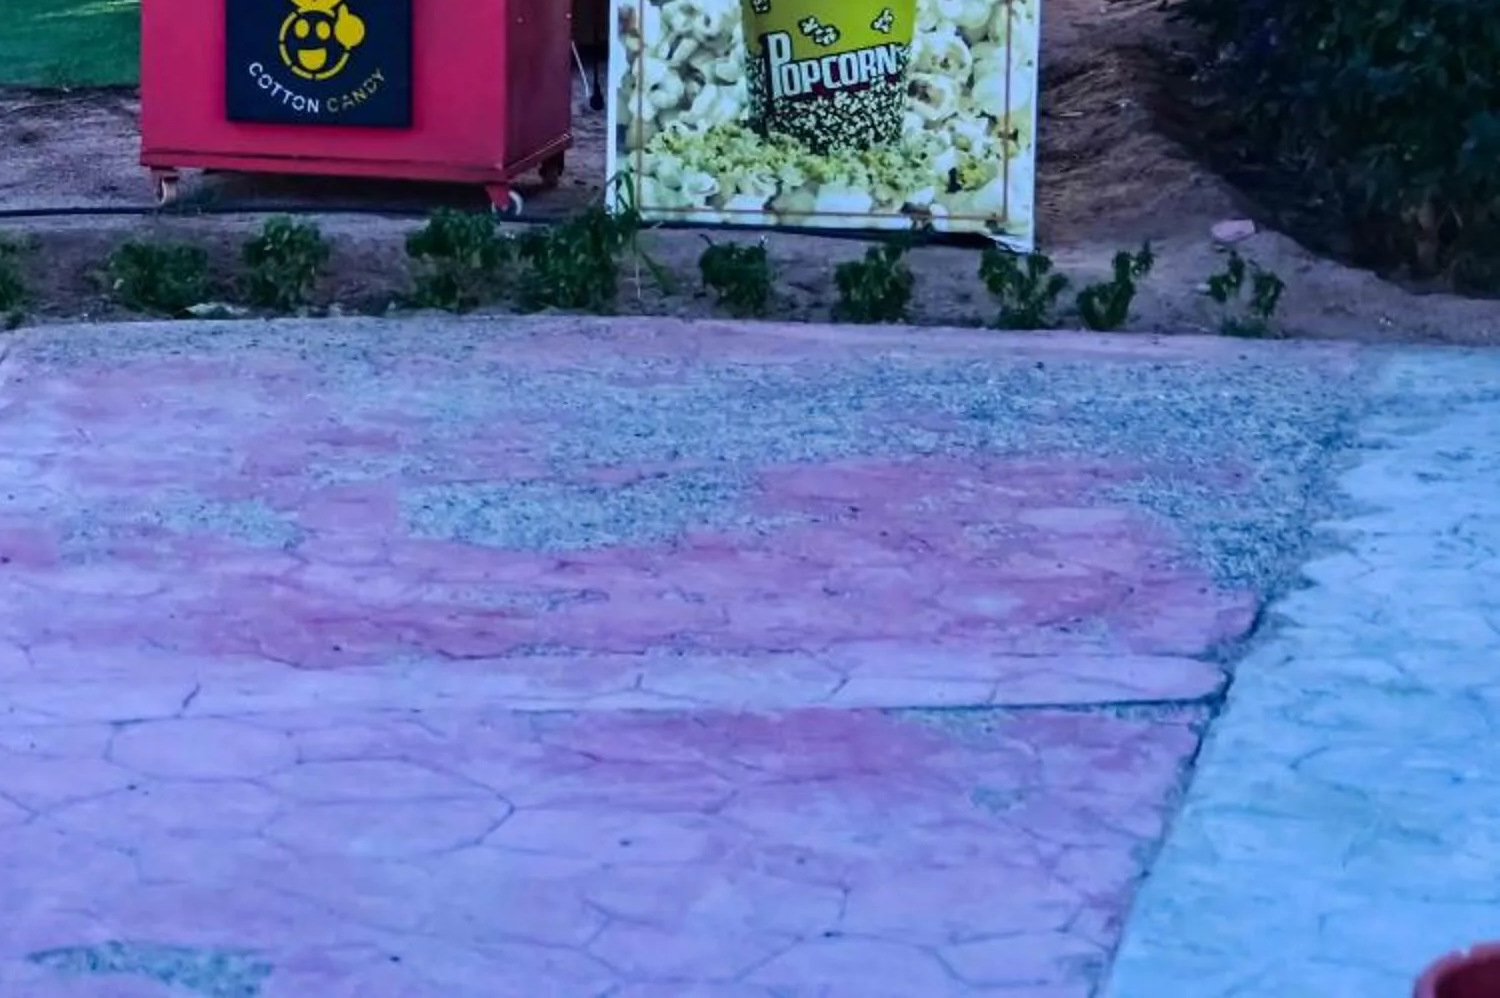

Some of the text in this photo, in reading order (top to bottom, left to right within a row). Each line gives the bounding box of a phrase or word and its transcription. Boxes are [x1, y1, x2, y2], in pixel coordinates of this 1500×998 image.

[248, 62, 385, 113] COTTON CANDY
[767, 31, 898, 99] POPCORN
